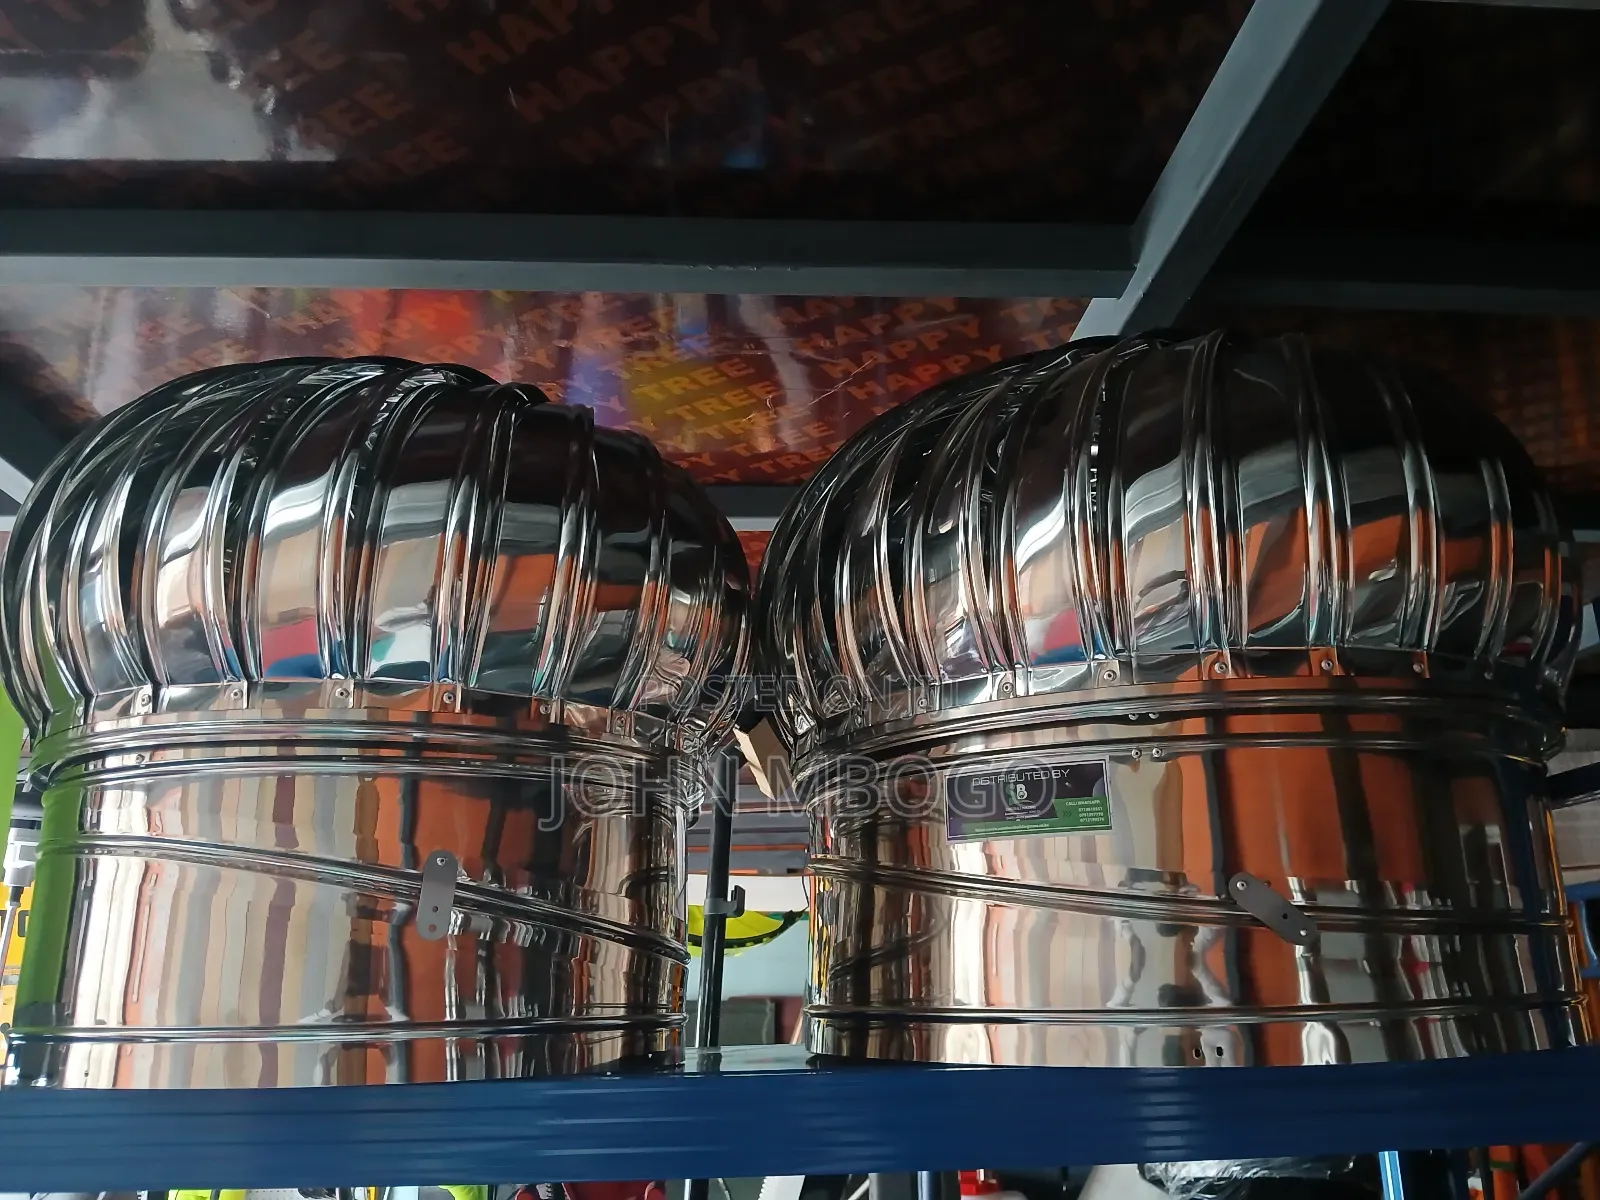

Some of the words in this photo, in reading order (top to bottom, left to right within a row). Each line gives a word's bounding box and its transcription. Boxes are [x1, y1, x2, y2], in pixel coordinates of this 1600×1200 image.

[818, 312, 979, 379] HAPPY
[631, 356, 756, 402] TREE
[846, 343, 1002, 401] HAPPY
[665, 379, 784, 423] TREE
[972, 770, 1050, 787] DISTRIBUTED
[1052, 768, 1070, 780] BY
